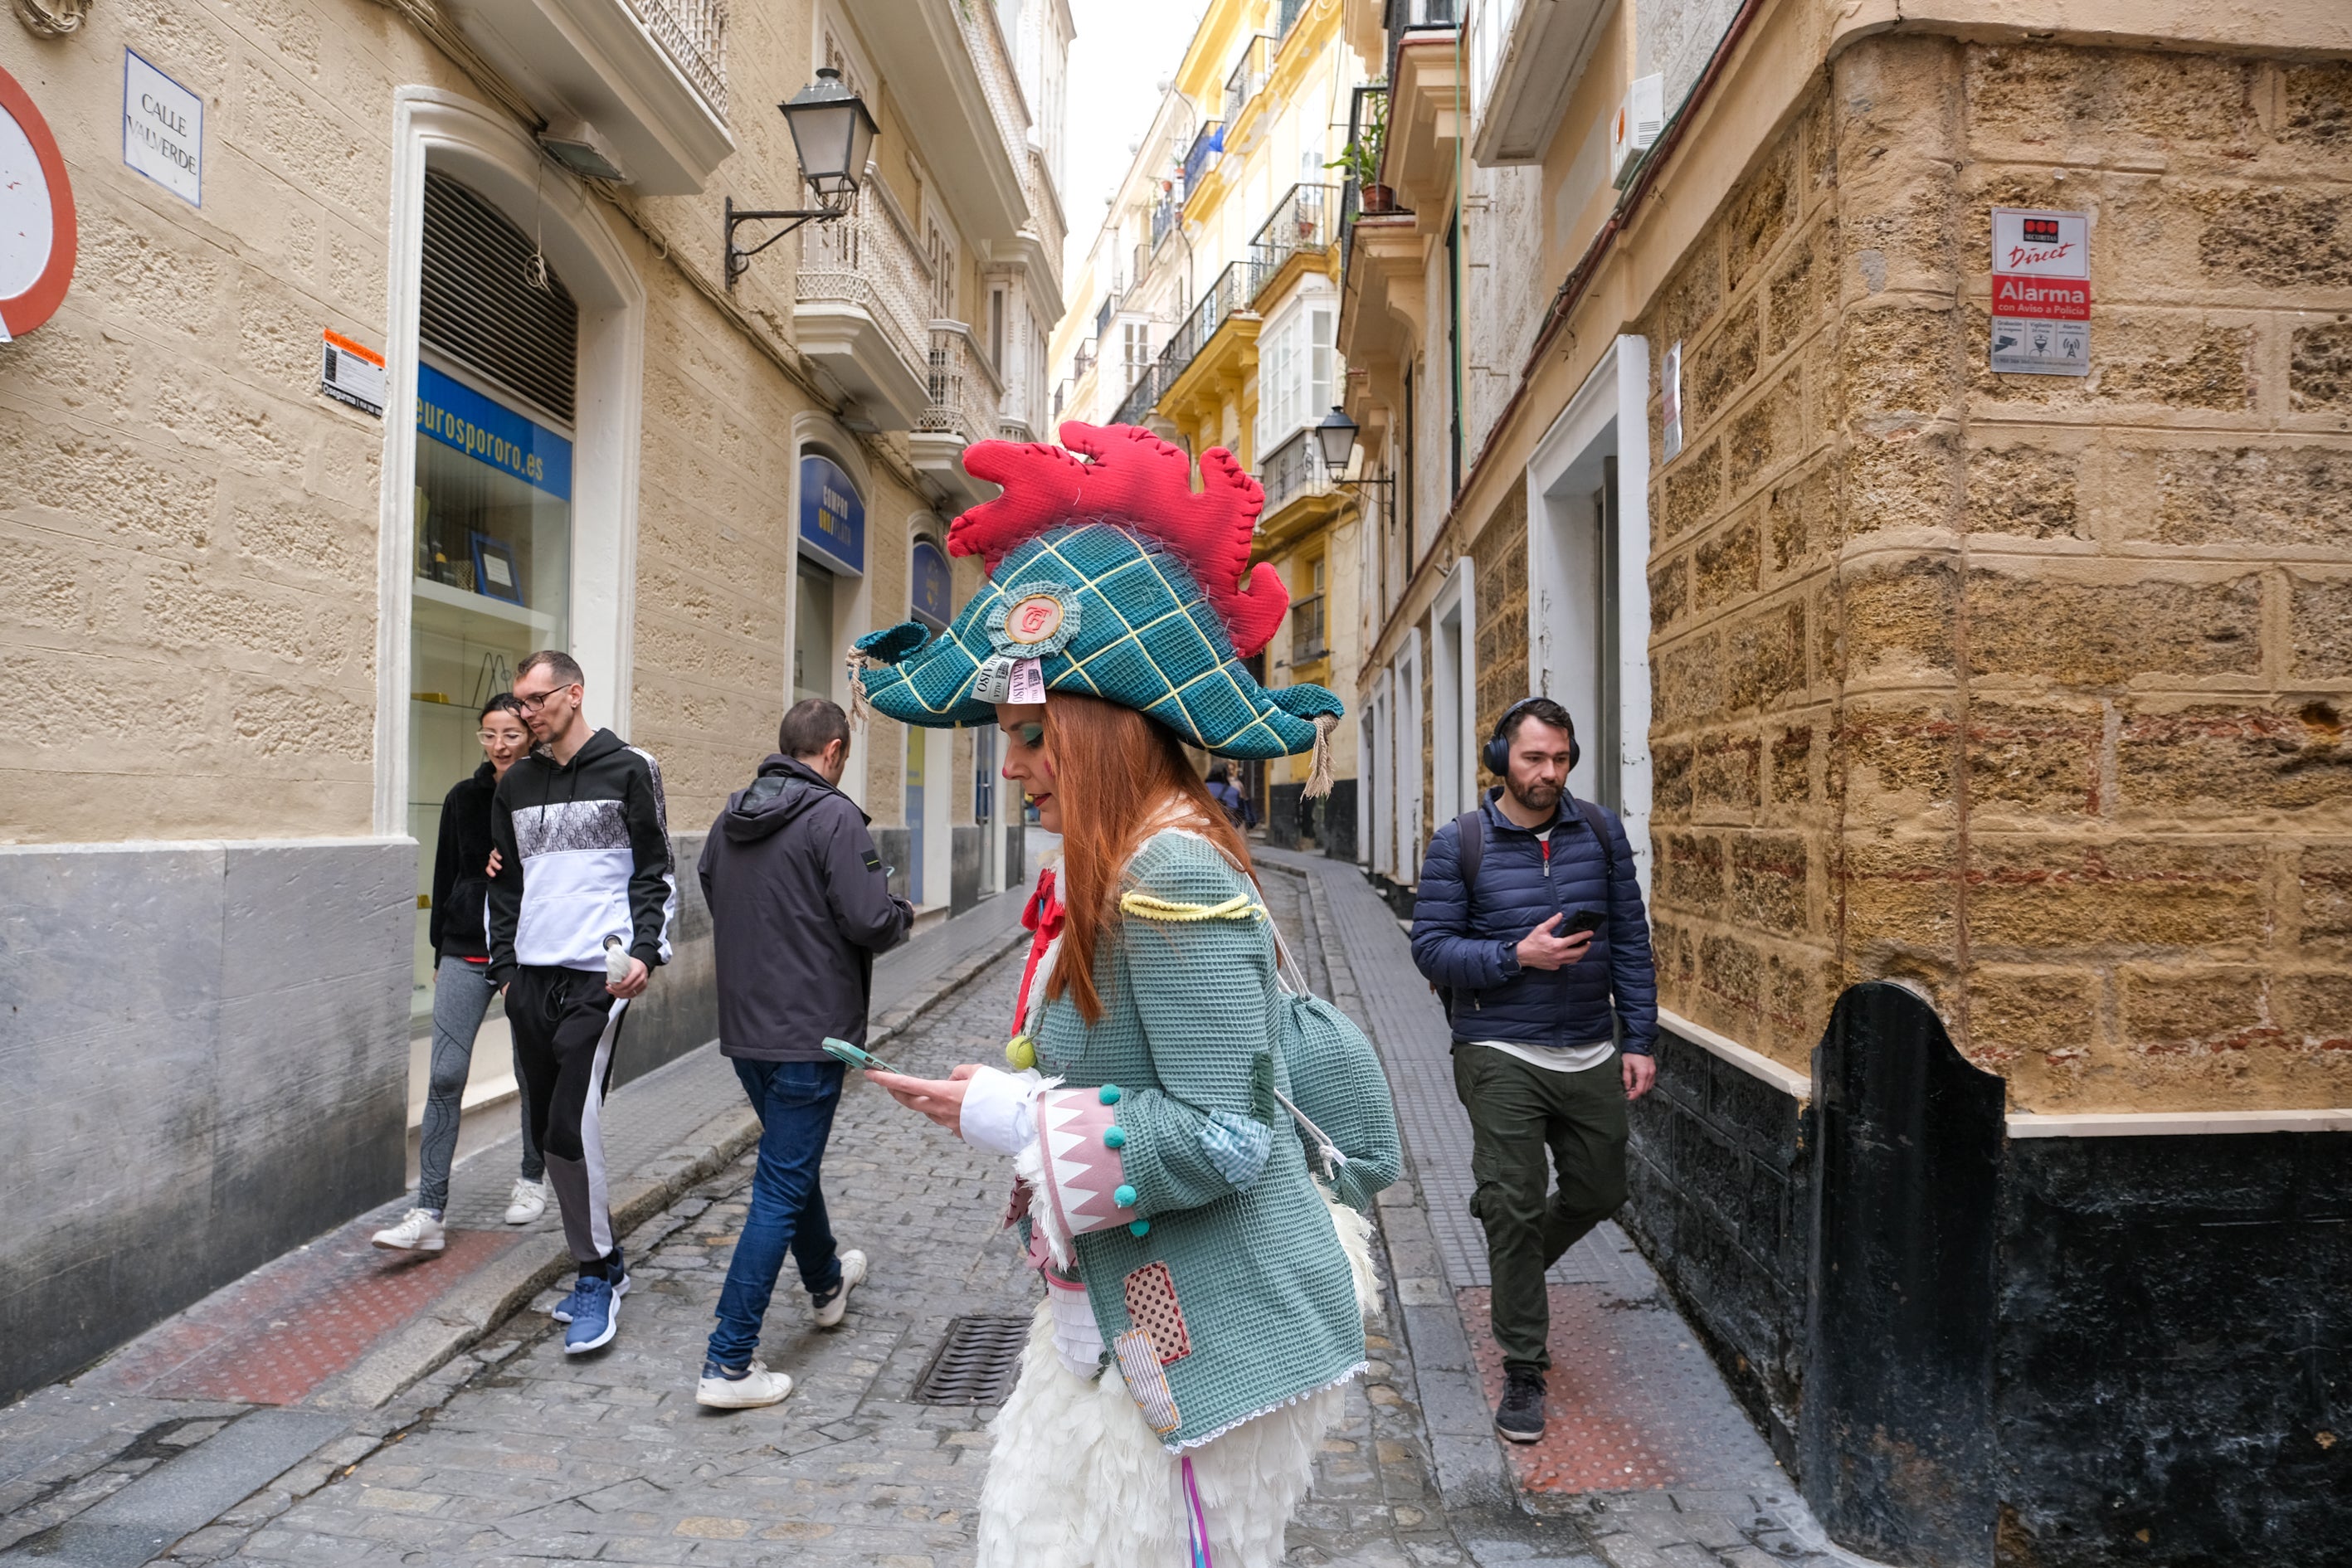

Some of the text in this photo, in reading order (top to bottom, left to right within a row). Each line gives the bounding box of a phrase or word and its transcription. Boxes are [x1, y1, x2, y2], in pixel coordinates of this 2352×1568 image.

[142, 93, 187, 138] CALLE
[127, 114, 197, 176] VALVERDE
[2025, 233, 2057, 241] SECURITAS
[2008, 242, 2077, 269] Direct
[1999, 280, 2085, 304] Alarma
[2017, 304, 2043, 313] Aviso
[2053, 305, 2085, 315] Policía
[416, 397, 543, 481] eurospororo.es
[993, 682, 1002, 698] FALLA
[1013, 662, 1027, 703] PARAÍSO
